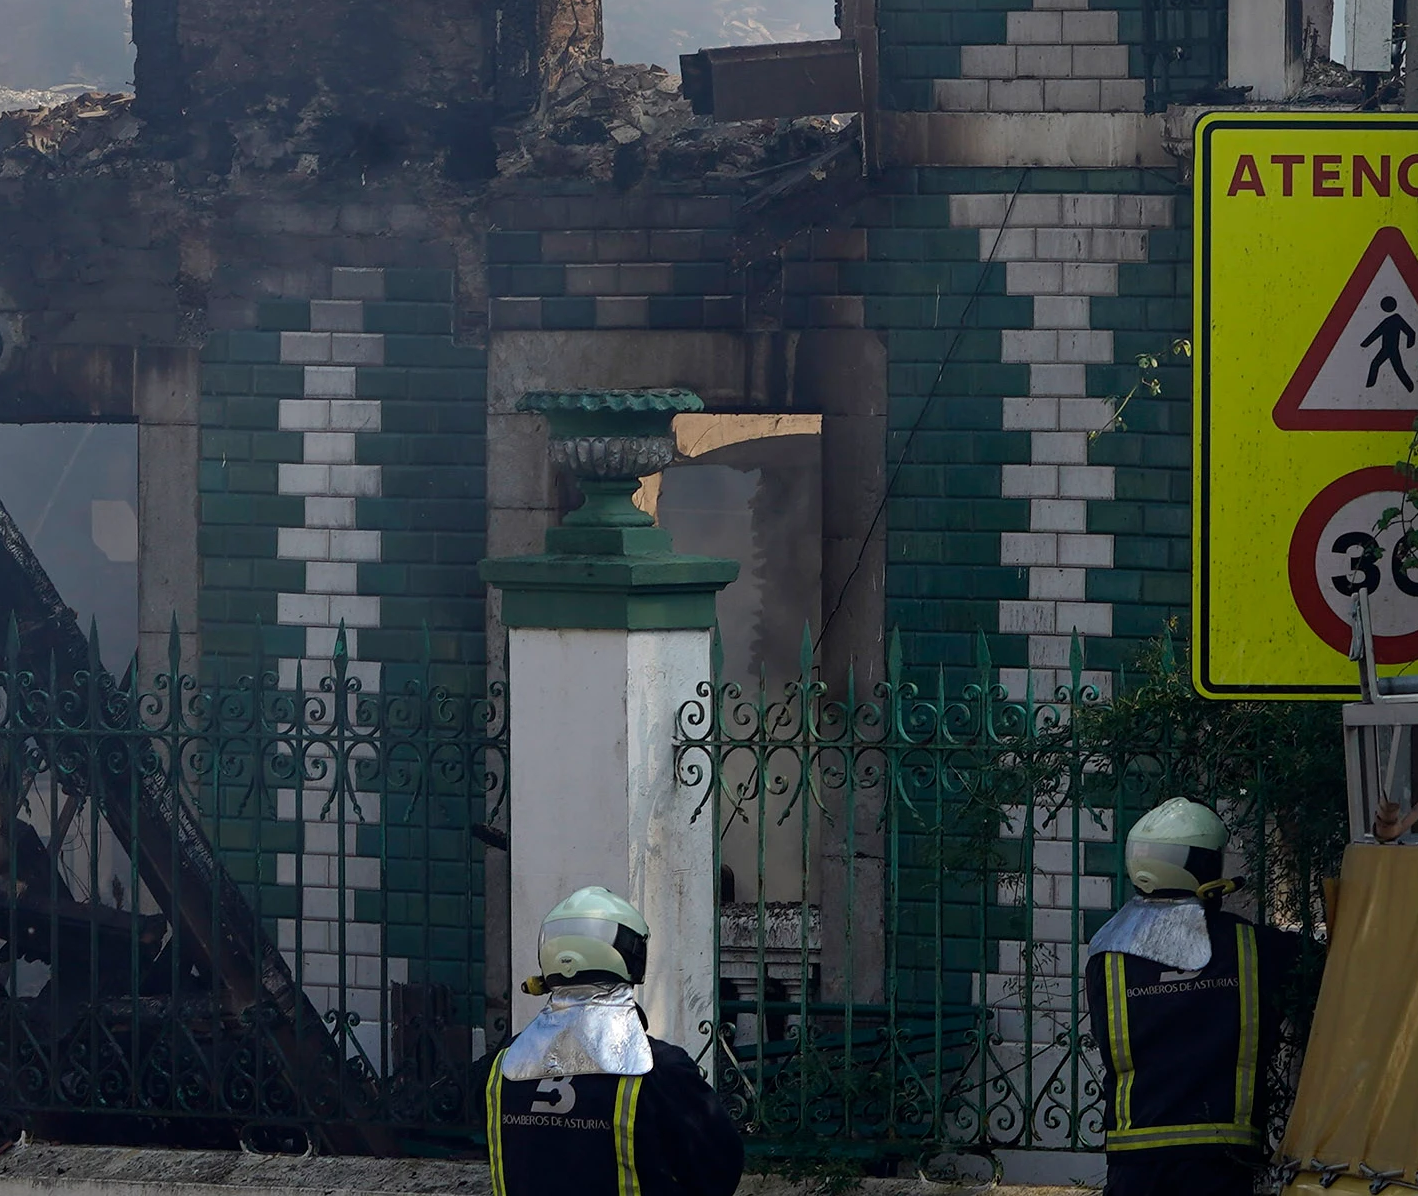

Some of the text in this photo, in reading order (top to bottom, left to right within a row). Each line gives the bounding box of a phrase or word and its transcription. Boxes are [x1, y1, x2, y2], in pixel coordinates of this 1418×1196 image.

[1127, 978, 1239, 997] BOMBEROS DE ASTURIAS
[503, 1115, 611, 1129] BOMBEROS DE ASTURIAS
